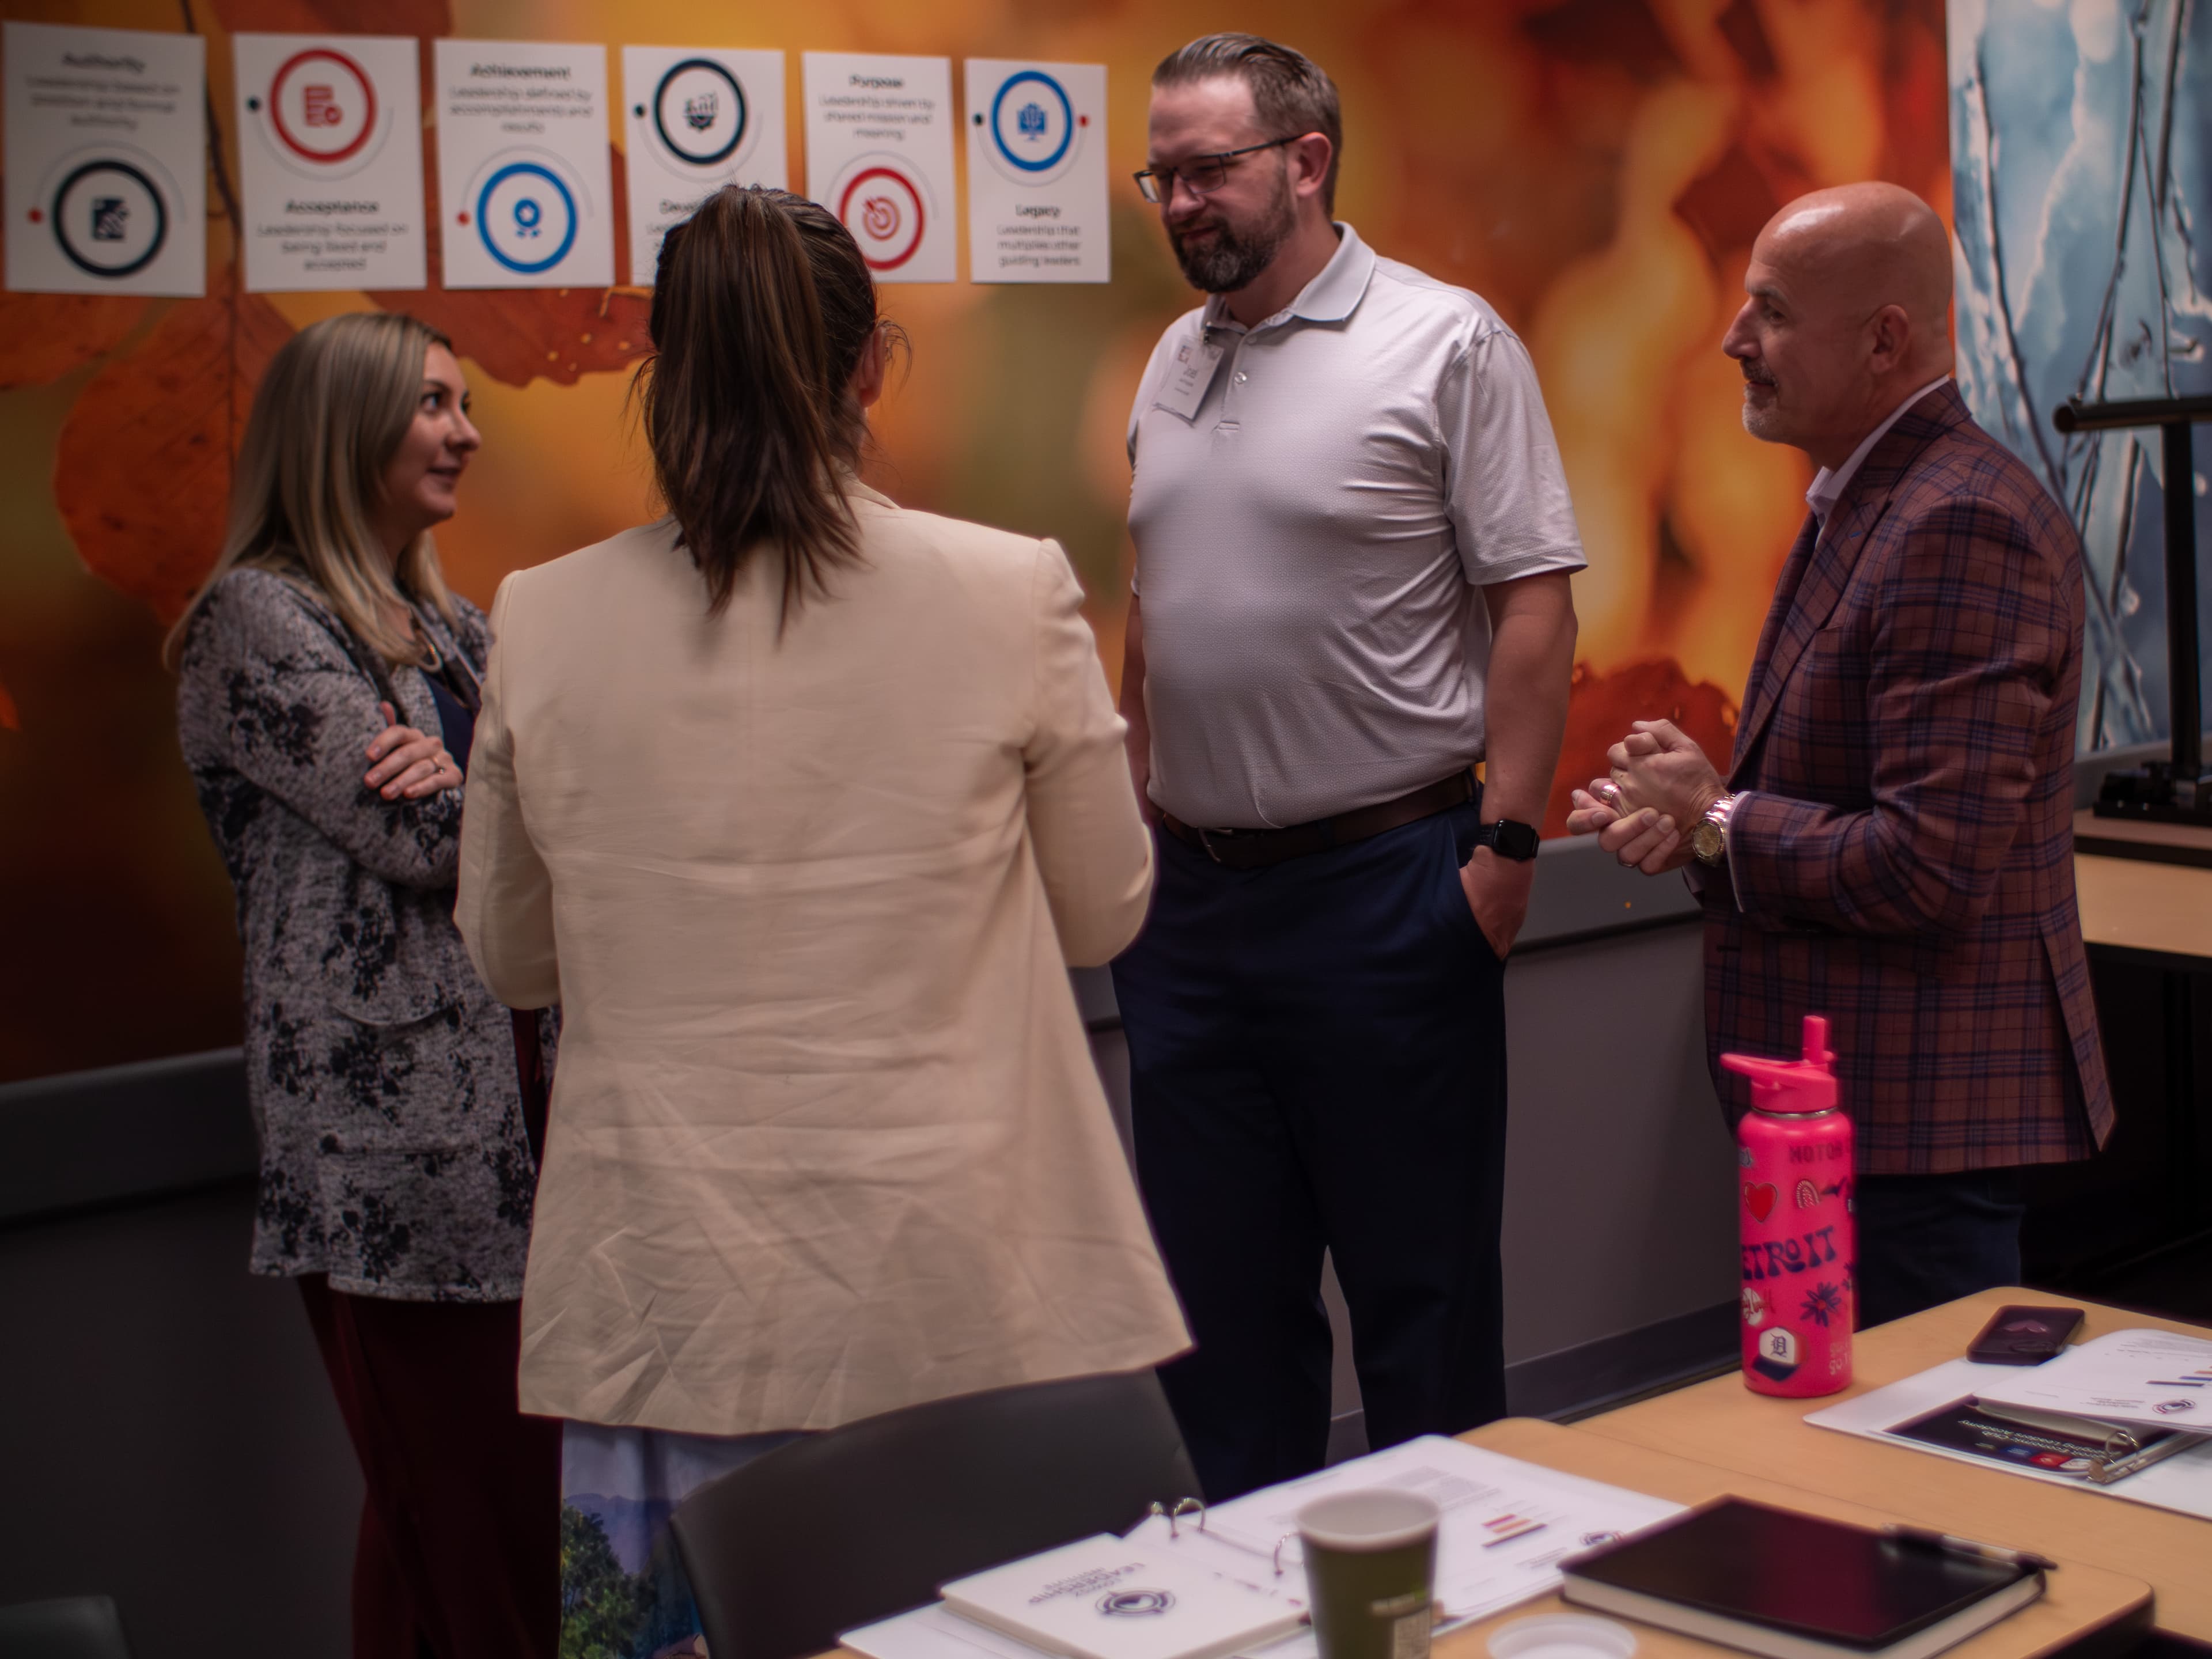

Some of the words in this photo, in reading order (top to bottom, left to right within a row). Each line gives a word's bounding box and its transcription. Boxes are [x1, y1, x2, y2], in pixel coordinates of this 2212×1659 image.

[61, 52, 146, 74] Authority
[469, 62, 571, 80] Achievement
[849, 73, 905, 90] Purpose
[449, 86, 522, 100] Leadership
[525, 88, 575, 100] defined
[576, 88, 593, 103] by
[819, 93, 884, 109] Leadership
[885, 96, 916, 108] driven
[918, 97, 935, 111] by
[569, 104, 594, 117] and
[824, 111, 865, 122] shared
[908, 113, 932, 125] and
[854, 128, 906, 142] meaning
[285, 199, 380, 217] Acceptance
[659, 199, 703, 214] Deve
[1015, 203, 1062, 219] Legacy
[257, 223, 331, 238] Leadership
[336, 222, 389, 236] focused
[391, 224, 409, 235] on
[997, 223, 1055, 237] Leadership
[1057, 224, 1081, 236] that
[361, 240, 388, 253] and
[999, 255, 1040, 269] guiding
